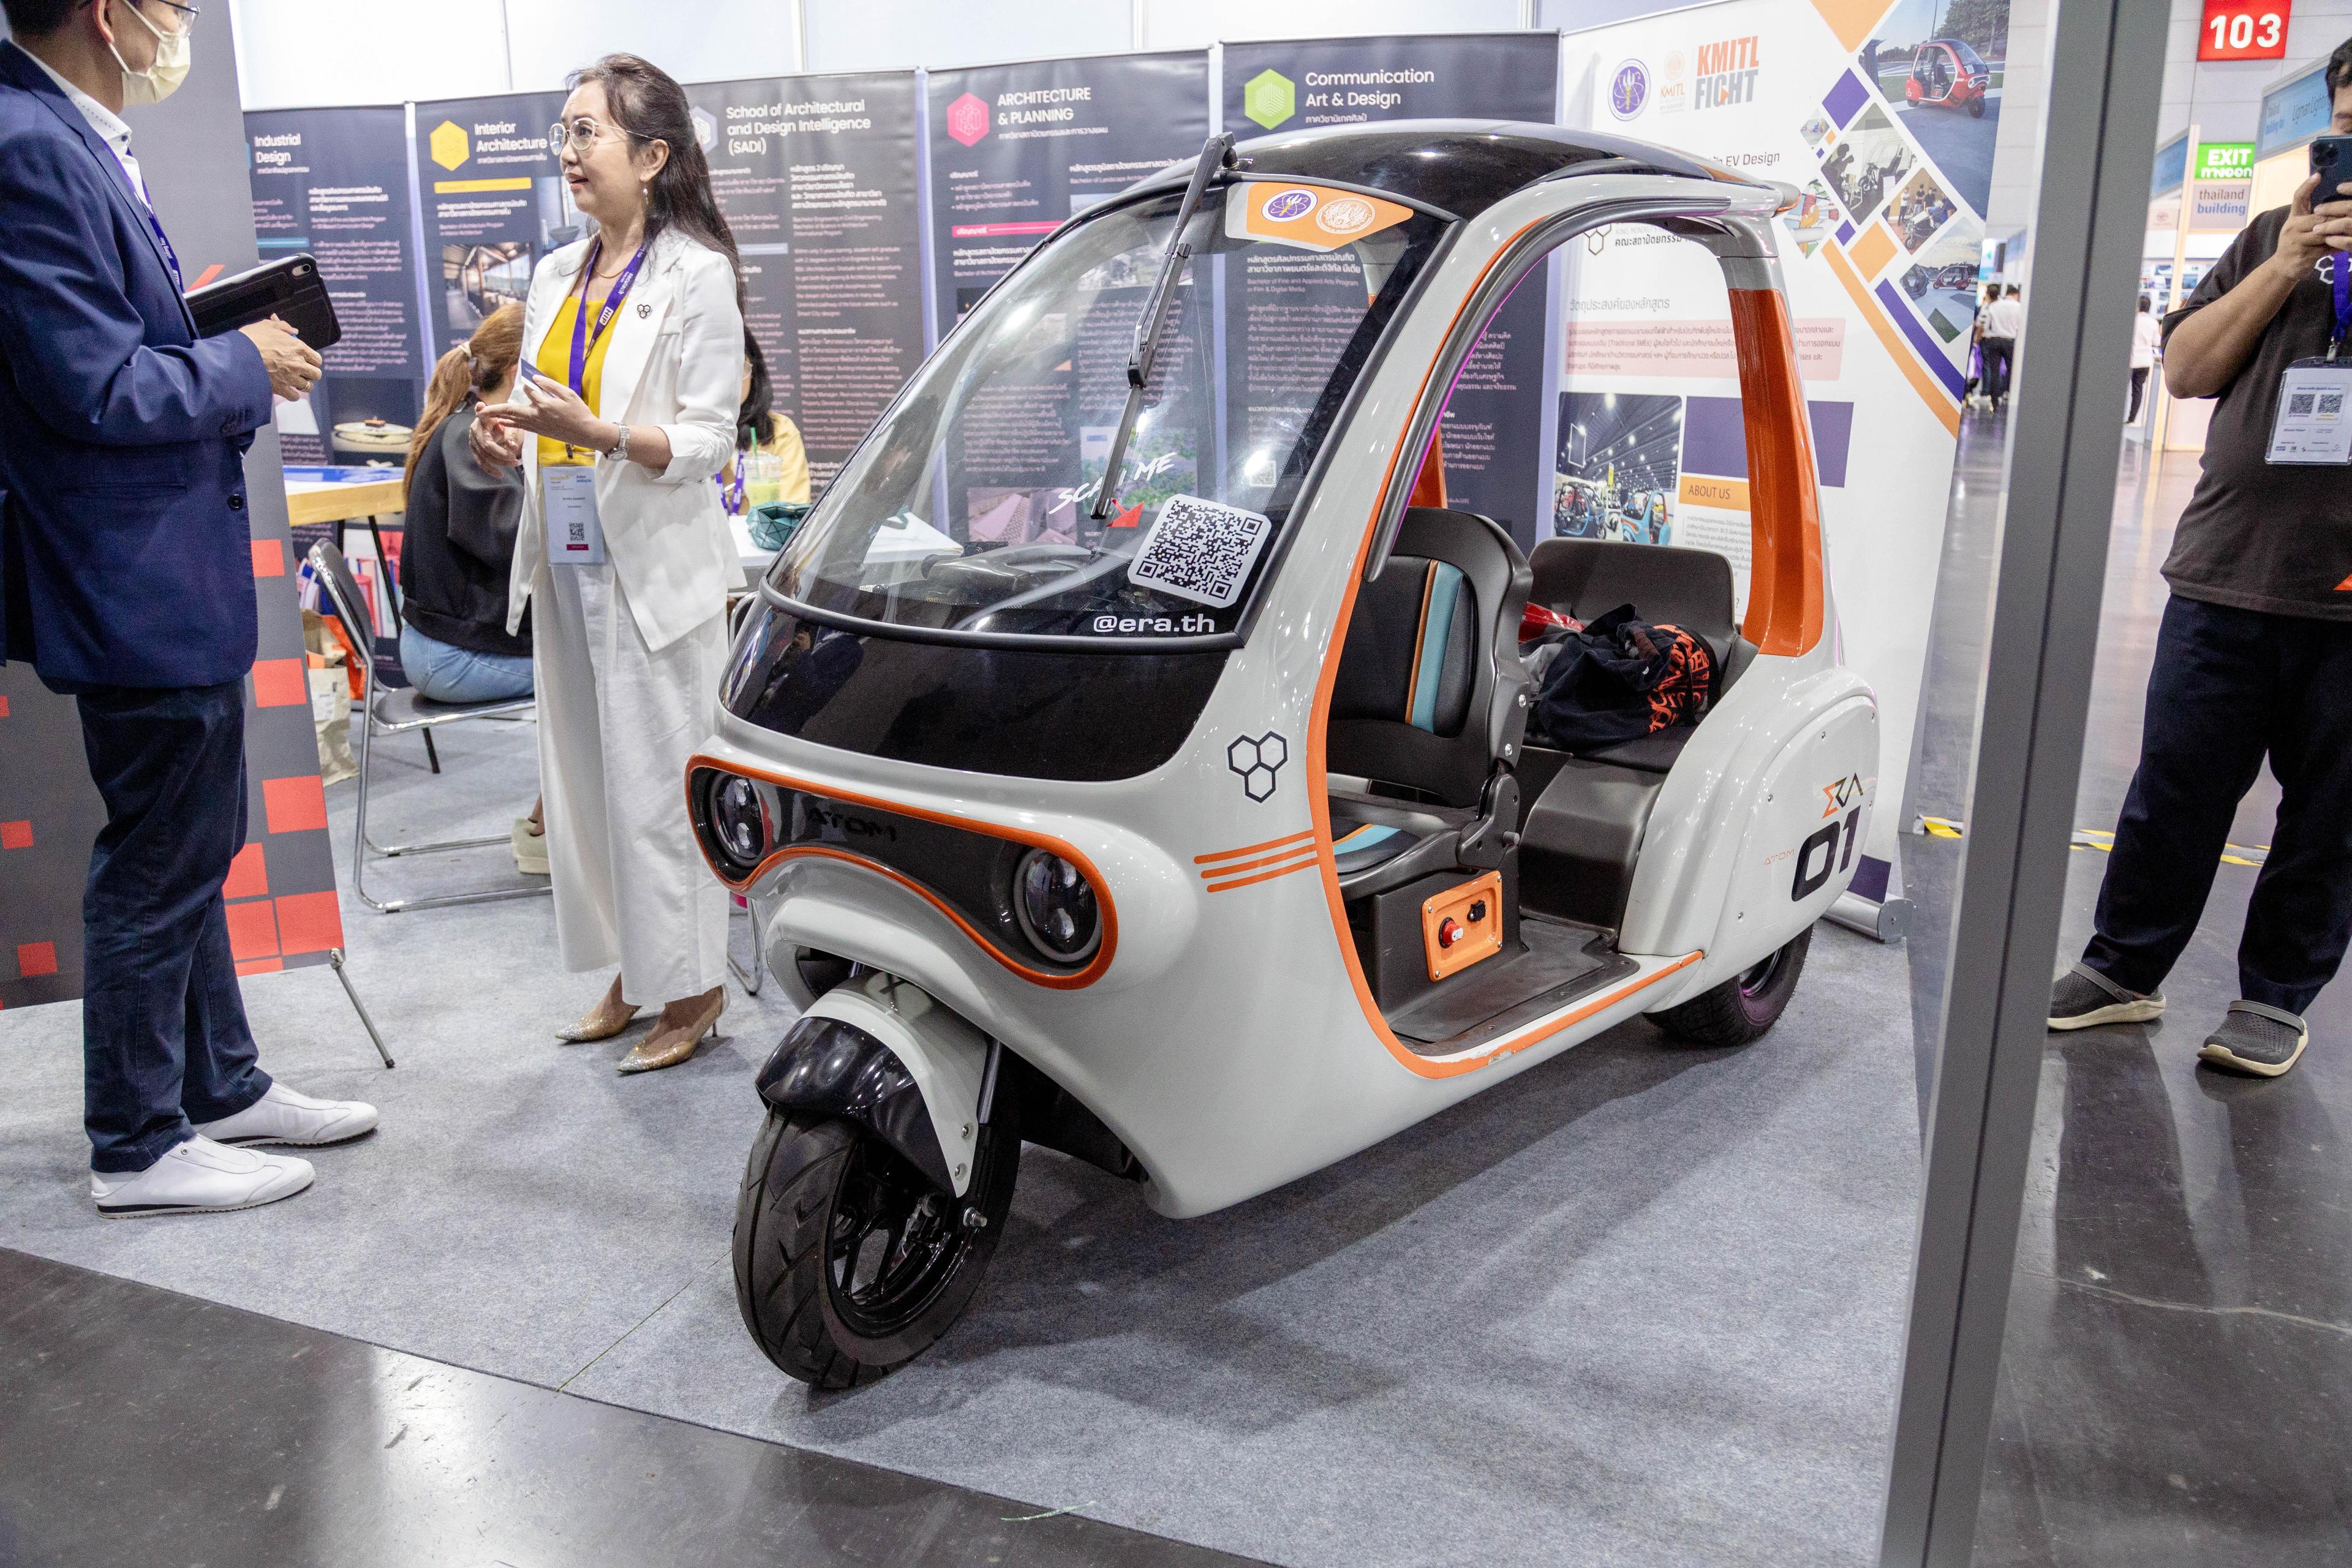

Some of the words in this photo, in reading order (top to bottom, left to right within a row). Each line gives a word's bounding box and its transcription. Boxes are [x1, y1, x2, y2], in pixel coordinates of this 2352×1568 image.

[2210, 13, 2282, 50] 103
[1697, 36, 1760, 77] KMITL
[1305, 69, 1434, 86] Communication
[997, 87, 1091, 107] ARCHITECTURE
[1660, 83, 1686, 99] KMITL
[1694, 69, 1759, 110] FIGHT
[1305, 92, 1329, 107] Art
[1331, 92, 1344, 107] &
[1348, 90, 1401, 110] Design
[726, 104, 768, 119] School
[770, 102, 783, 117] of
[784, 99, 865, 116] Architectural
[998, 112, 1008, 126] &
[1011, 107, 1074, 124] PLANNING
[474, 121, 516, 137] Interior
[727, 123, 752, 136] and
[755, 121, 796, 137] Design
[799, 117, 872, 135] Intelligence
[254, 134, 301, 148] Industrial
[476, 137, 548, 153] Architecture
[728, 137, 766, 156] (SADI)
[255, 151, 292, 167] Design
[1725, 156, 1741, 167] EV
[1743, 153, 1781, 167] Design
[2207, 149, 2252, 166] EXIT
[2199, 189, 2245, 201] thailand
[2197, 203, 2247, 217] building
[1615, 235, 1682, 247] คณะสถาปัตยกรรม
[1570, 297, 1671, 314] วัตถุประสงค์ของหลักสูตร
[601, 308, 612, 324] HIP
[1134, 452, 1178, 481] ME
[1688, 484, 1717, 499] ABOUT
[1719, 488, 1731, 500] US
[1093, 613, 1215, 633] @era.th
[1764, 848, 1795, 865] ATOM
[1791, 805, 1861, 902] 01
